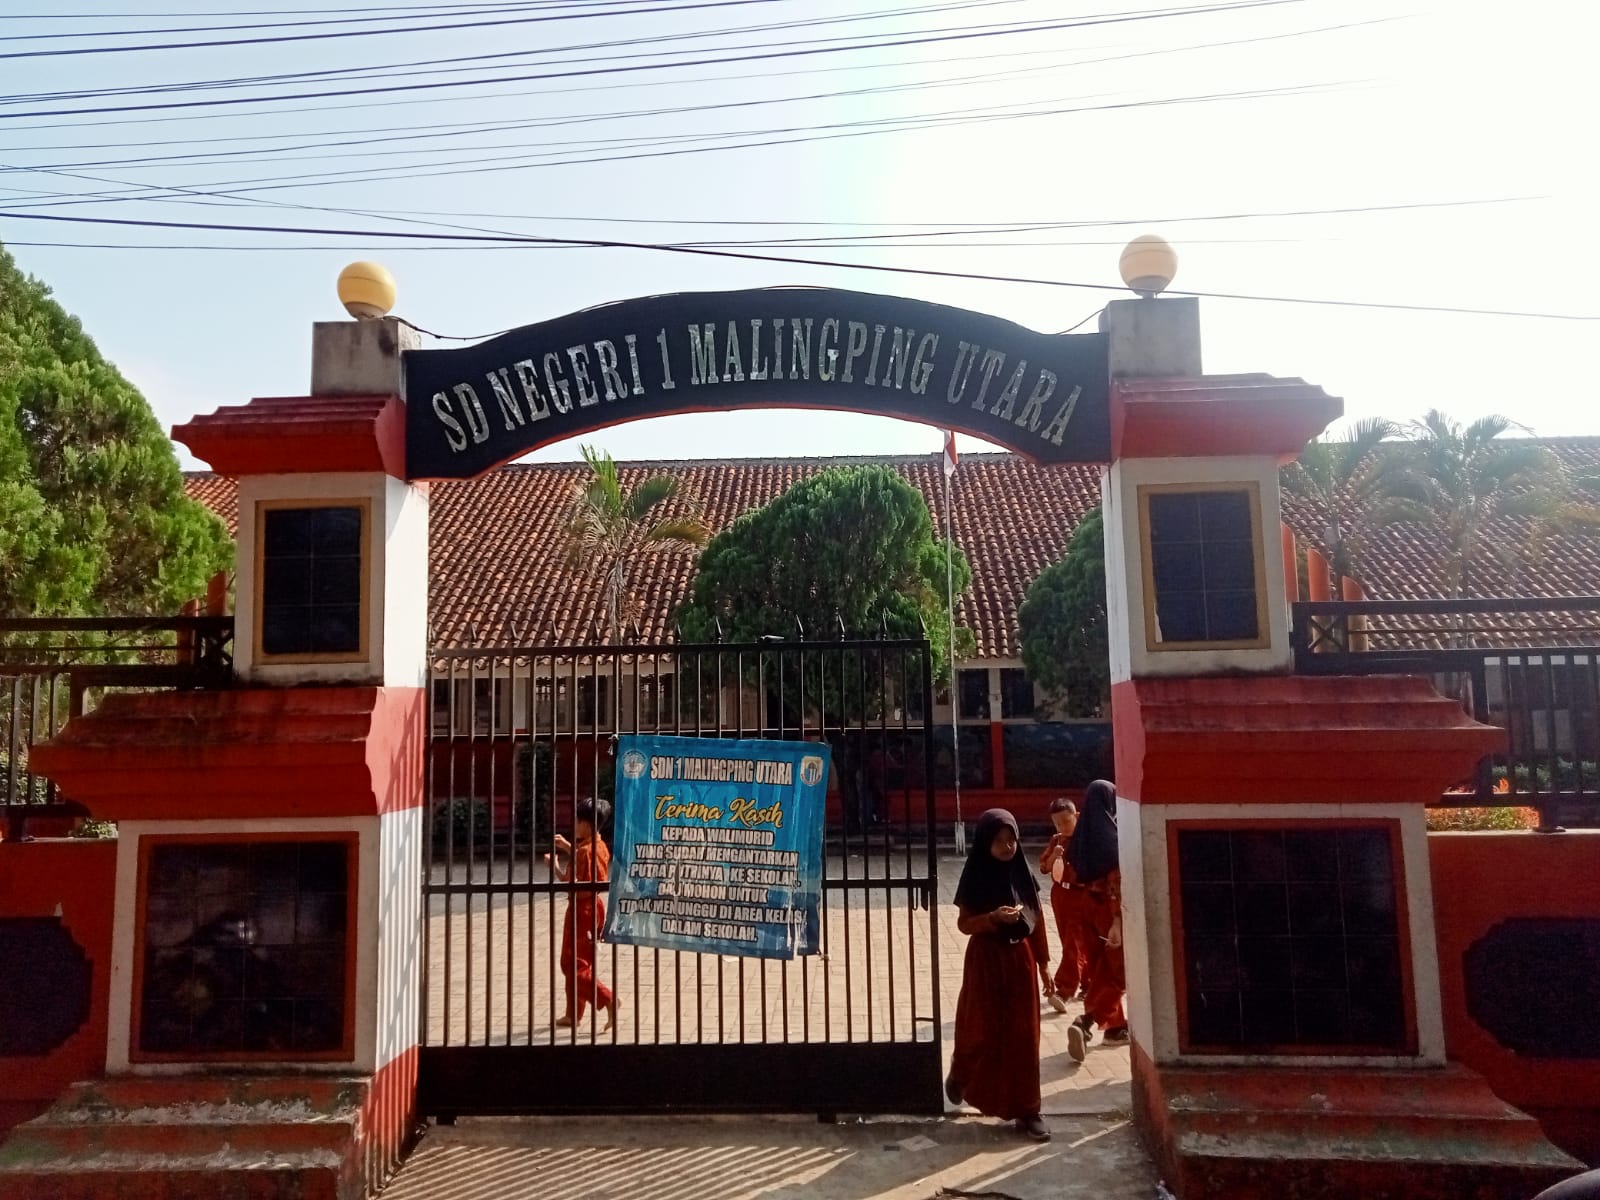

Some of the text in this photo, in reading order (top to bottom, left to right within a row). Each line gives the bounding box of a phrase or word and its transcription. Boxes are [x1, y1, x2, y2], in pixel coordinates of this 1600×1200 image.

[431, 318, 1082, 453] SD NEGERI 1 MALINGPING UTARA
[650, 756, 793, 785] SDN 1 MALINGPING UTARA
[655, 795, 783, 829] Terima Kasih
[662, 826, 774, 846] KEPADA WALIMURID
[635, 844, 799, 867] YANG SUDAH MENGANTARKAN
[630, 863, 667, 878] PUTRA
[730, 867, 745, 883] KE
[657, 881, 768, 903] DA MOHON UNTUK
[653, 899, 718, 918] MENUNGGU
[719, 904, 732, 920] DI
[733, 906, 764, 922] AREA
[662, 918, 702, 936] DALAM
